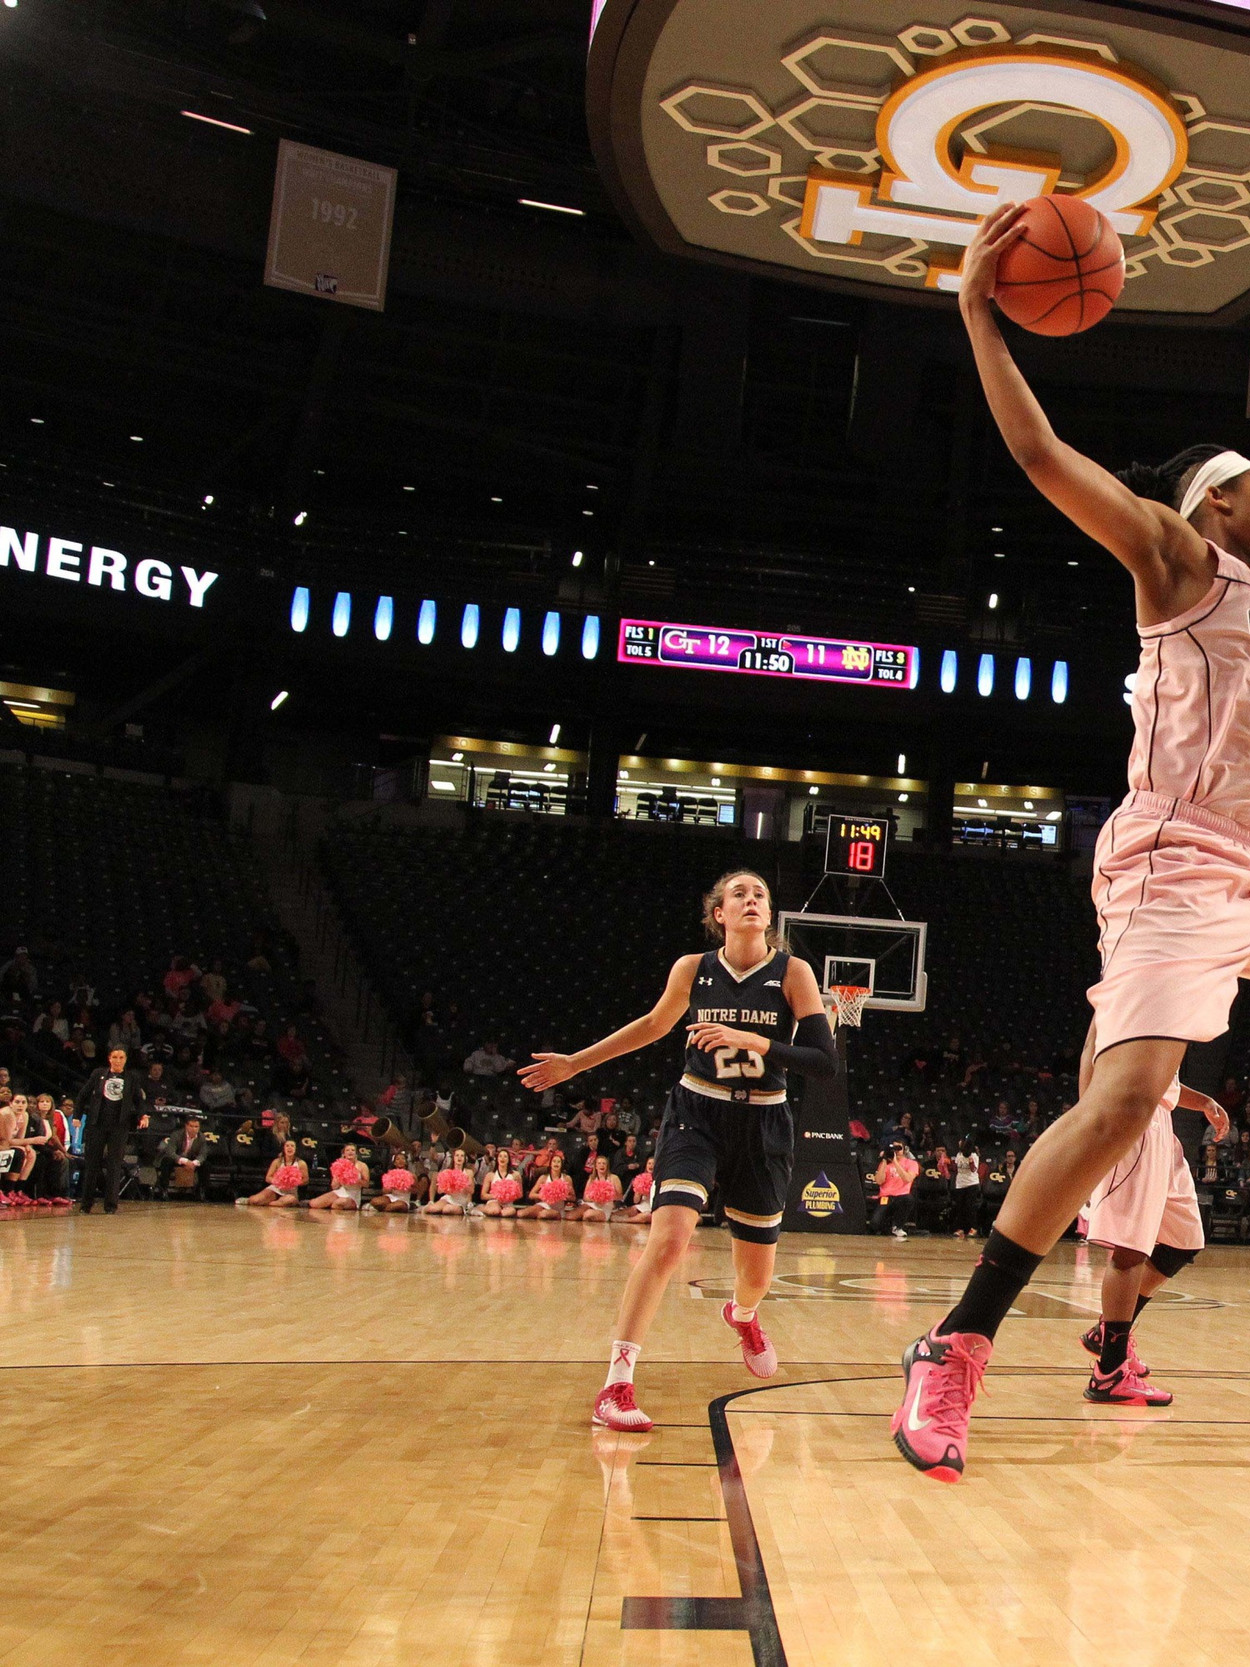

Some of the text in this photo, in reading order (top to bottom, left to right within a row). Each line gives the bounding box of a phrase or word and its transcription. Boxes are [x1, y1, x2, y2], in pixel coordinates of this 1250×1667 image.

[311, 197, 359, 230] 1992
[625, 625, 654, 641] FLS 1
[707, 634, 730, 656] 12
[760, 637, 779, 650] 1ST
[744, 651, 790, 673] 11:50
[806, 643, 826, 665] 11
[876, 650, 894, 663] FLS
[840, 823, 882, 842] 11:49
[849, 841, 875, 872] 18
[697, 1008, 779, 1026] NOTRE DAME
[805, 1187, 837, 1199] Superior
[805, 1200, 836, 1211] PLUMBING
